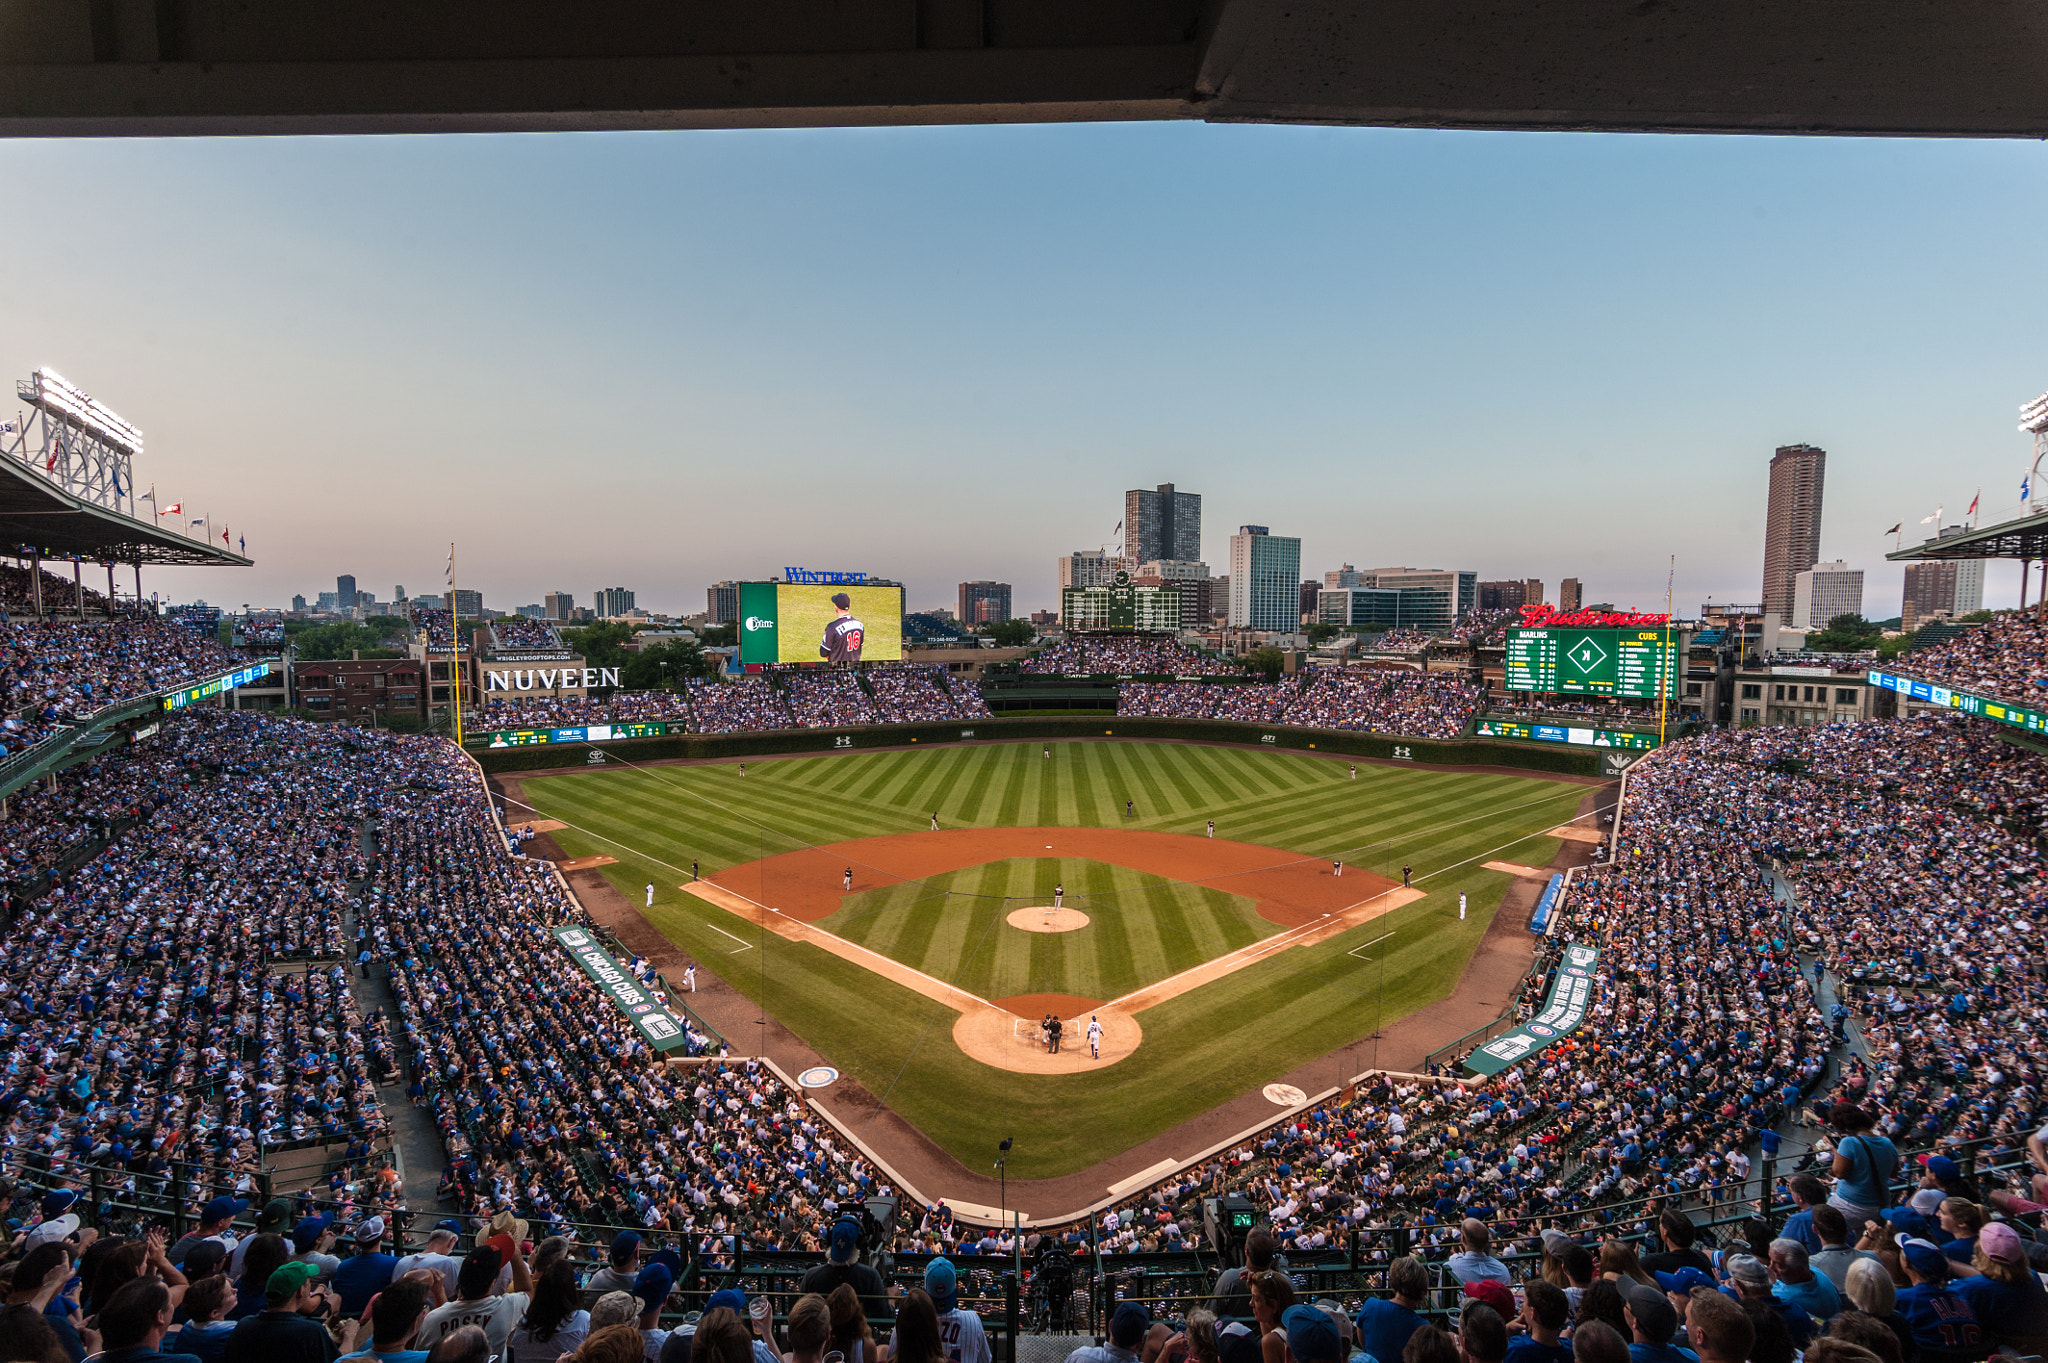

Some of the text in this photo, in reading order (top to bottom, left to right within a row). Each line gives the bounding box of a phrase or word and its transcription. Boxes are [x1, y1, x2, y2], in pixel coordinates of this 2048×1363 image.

[784, 566, 867, 584] WINTRUST
[1518, 604, 1673, 628] Budweiser
[847, 630, 861, 651] 16
[1638, 632, 1658, 640] CUBS
[488, 667, 620, 692] NUVEEN
[583, 952, 645, 1006] CHICAGO CUBS
